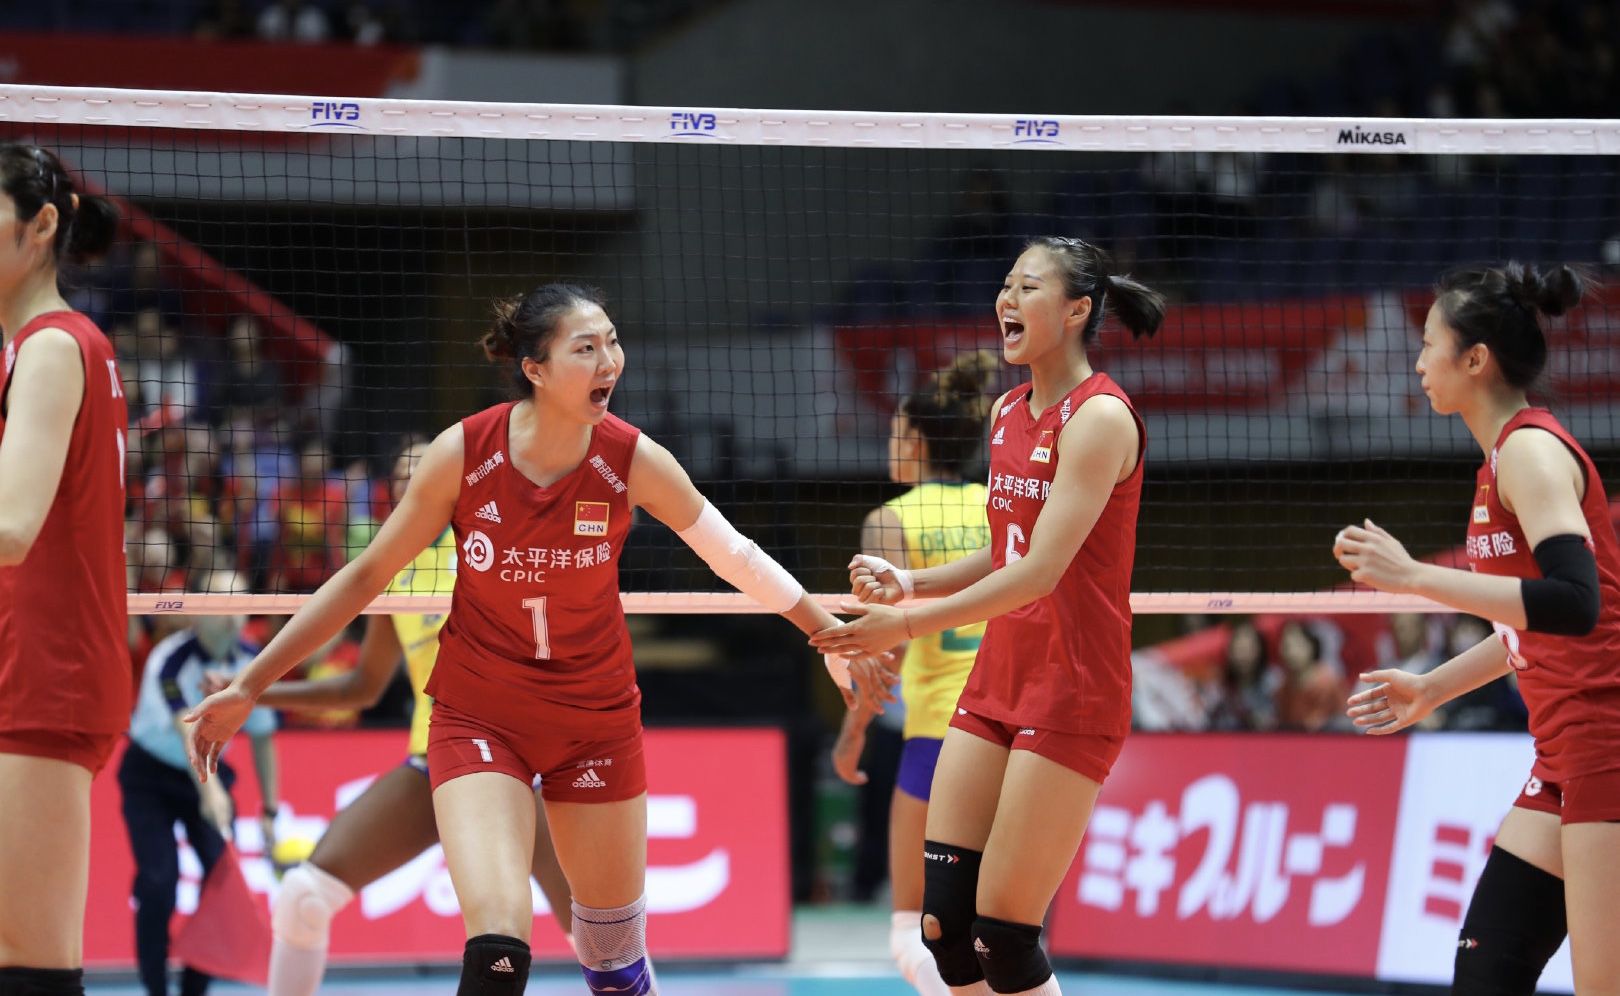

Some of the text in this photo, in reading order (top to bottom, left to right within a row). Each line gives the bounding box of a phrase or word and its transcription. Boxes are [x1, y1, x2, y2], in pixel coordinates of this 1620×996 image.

[312, 102, 360, 121] FIVB
[671, 112, 717, 130] FIVB
[1015, 120, 1060, 136] FIVB
[992, 496, 1014, 513] CPIC
[475, 511, 502, 524] adidas
[578, 523, 604, 533] CHN
[1005, 522, 1026, 567] 6
[501, 541, 612, 570] 太平洋保险
[500, 569, 546, 583] CPIC
[522, 595, 551, 660] 1
[472, 738, 493, 763] 1
[571, 780, 607, 788] adidas
